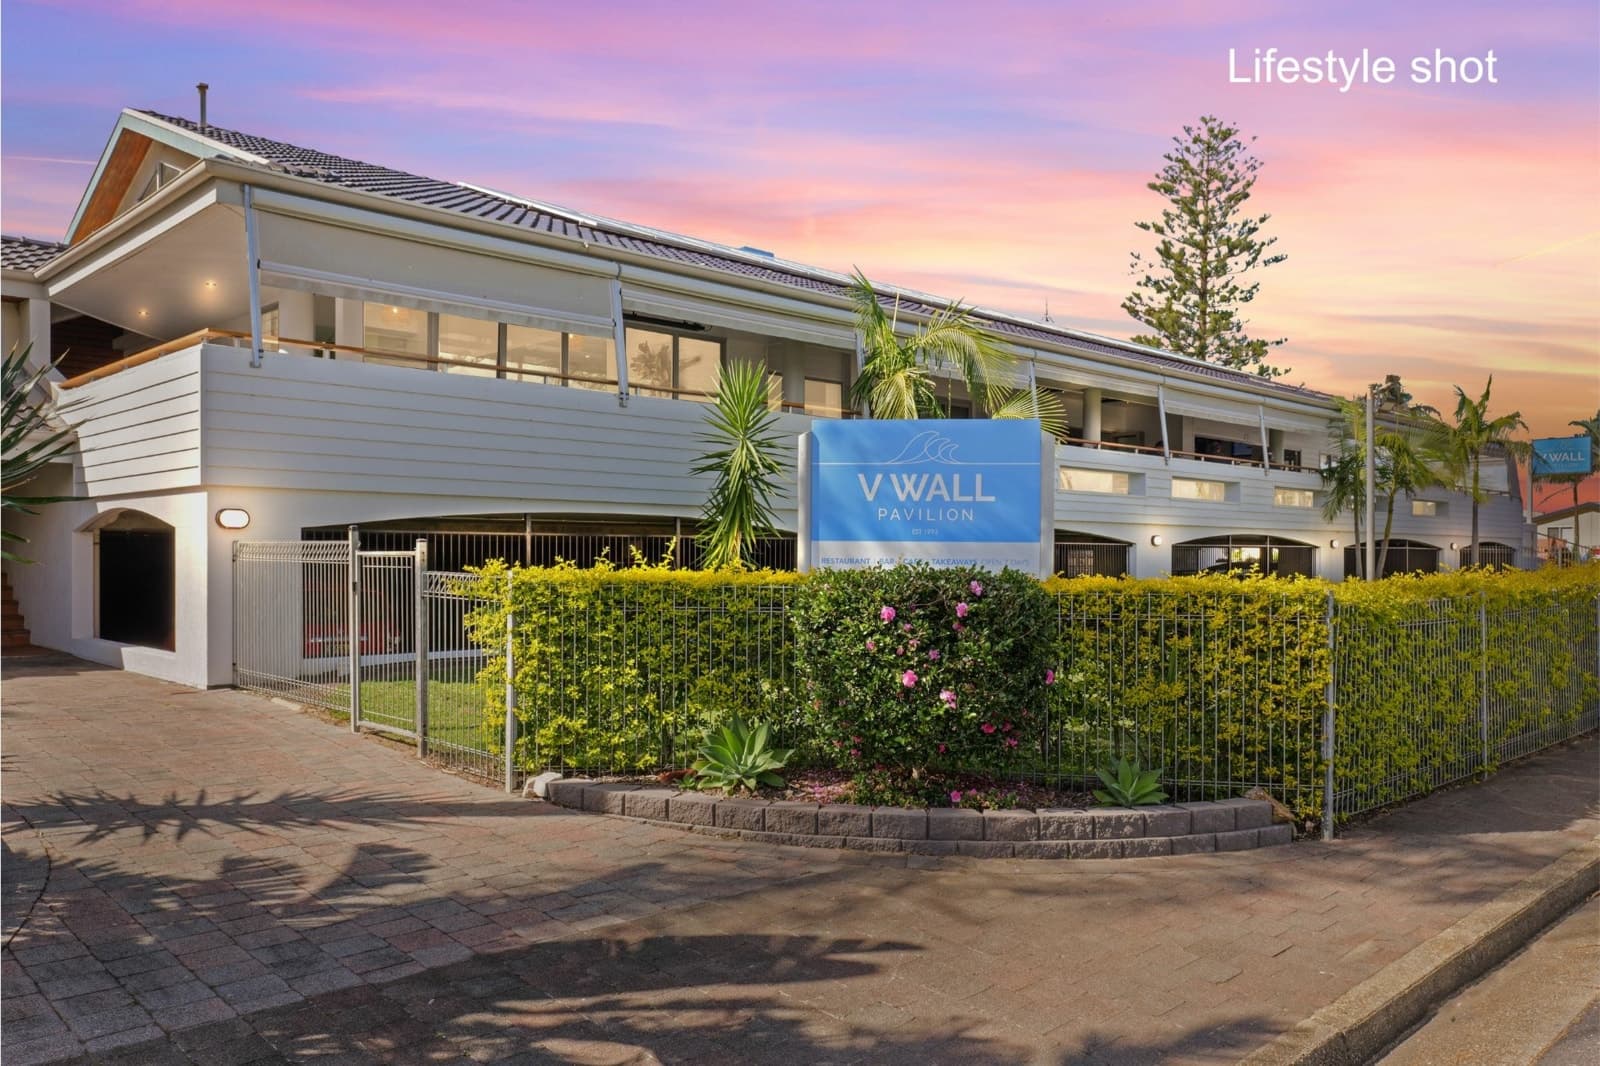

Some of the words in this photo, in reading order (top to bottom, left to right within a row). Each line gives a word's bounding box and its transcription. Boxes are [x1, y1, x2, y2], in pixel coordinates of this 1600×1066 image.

[1549, 451, 1585, 462] WALL
[857, 473, 883, 502] V
[889, 473, 996, 502] WALL
[878, 507, 974, 521] PAVILION
[821, 557, 870, 565] RESTAURANT
